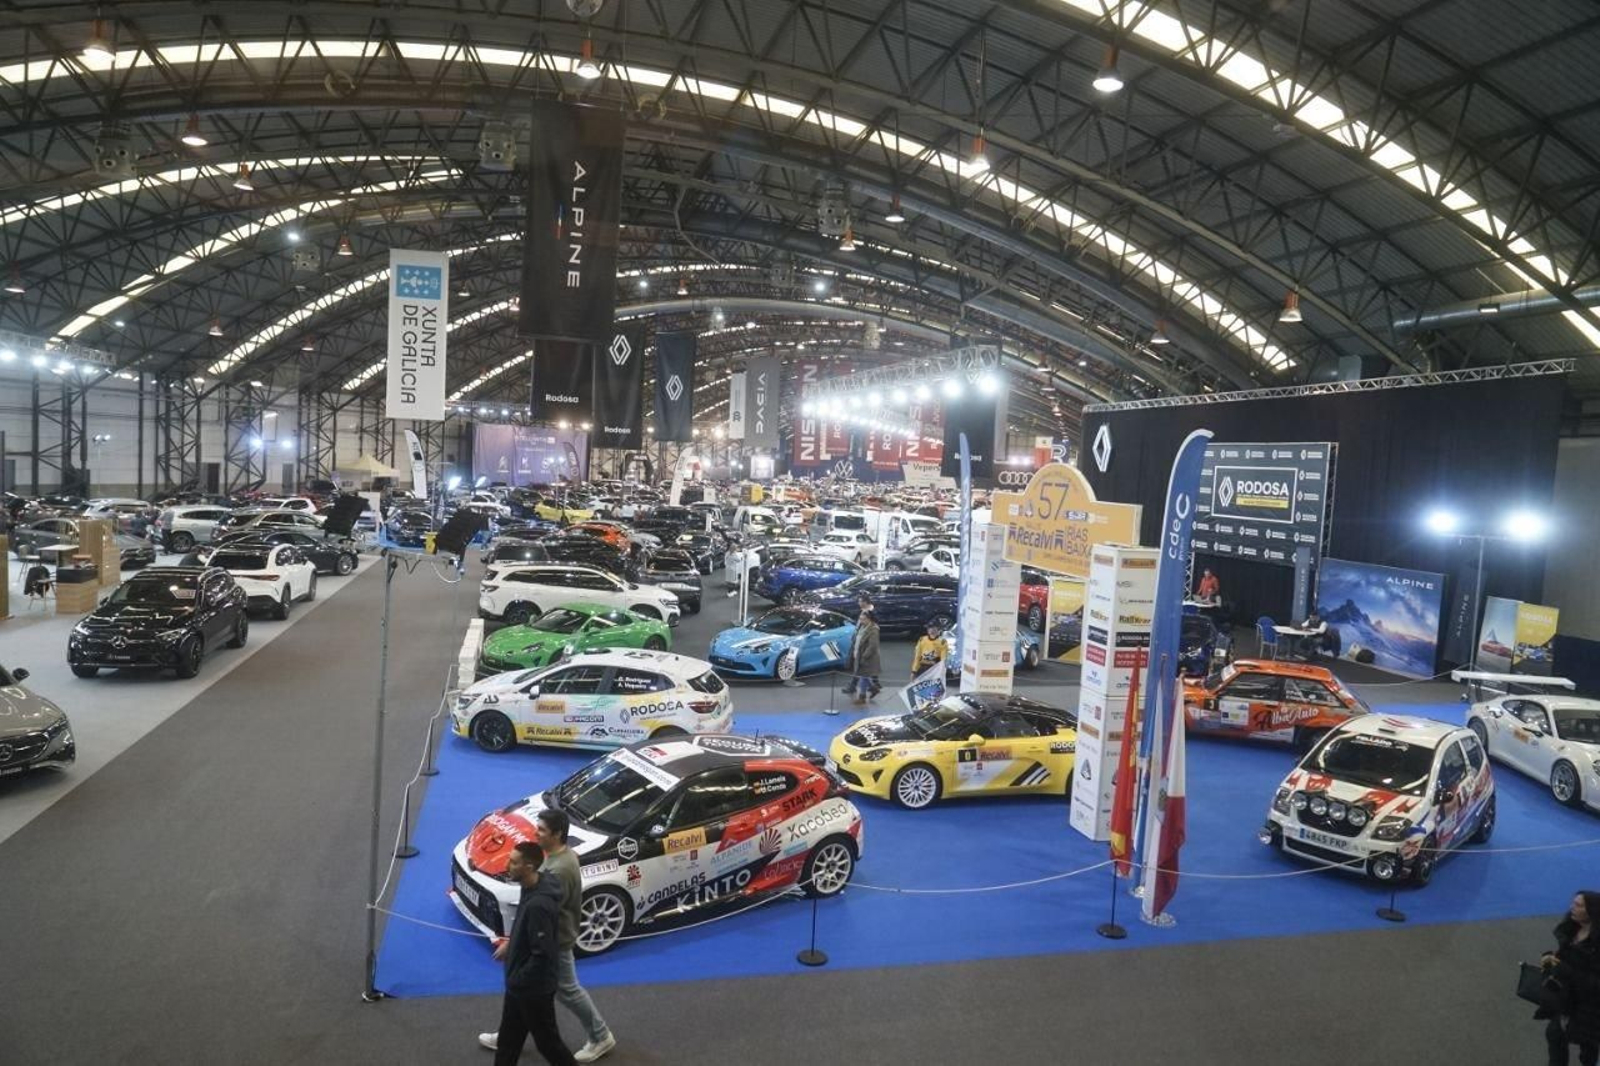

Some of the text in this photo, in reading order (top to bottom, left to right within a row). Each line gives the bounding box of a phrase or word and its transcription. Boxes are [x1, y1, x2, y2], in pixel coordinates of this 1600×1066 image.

[567, 161, 587, 288] ALPINE
[420, 306, 437, 368] XUNTA
[400, 304, 418, 404] DE GALICIA
[545, 393, 580, 404] Rodosa
[755, 372, 766, 434] DACIA
[1037, 481, 1070, 521] 57
[1236, 480, 1290, 496] RODOSA
[1016, 524, 1054, 551] Recalvi
[1386, 576, 1435, 590] ALPINE
[782, 788, 818, 812] STARK
[786, 802, 848, 842] Xacobeo
[667, 831, 702, 849] Recalvi
[648, 872, 706, 904] CANDELAS
